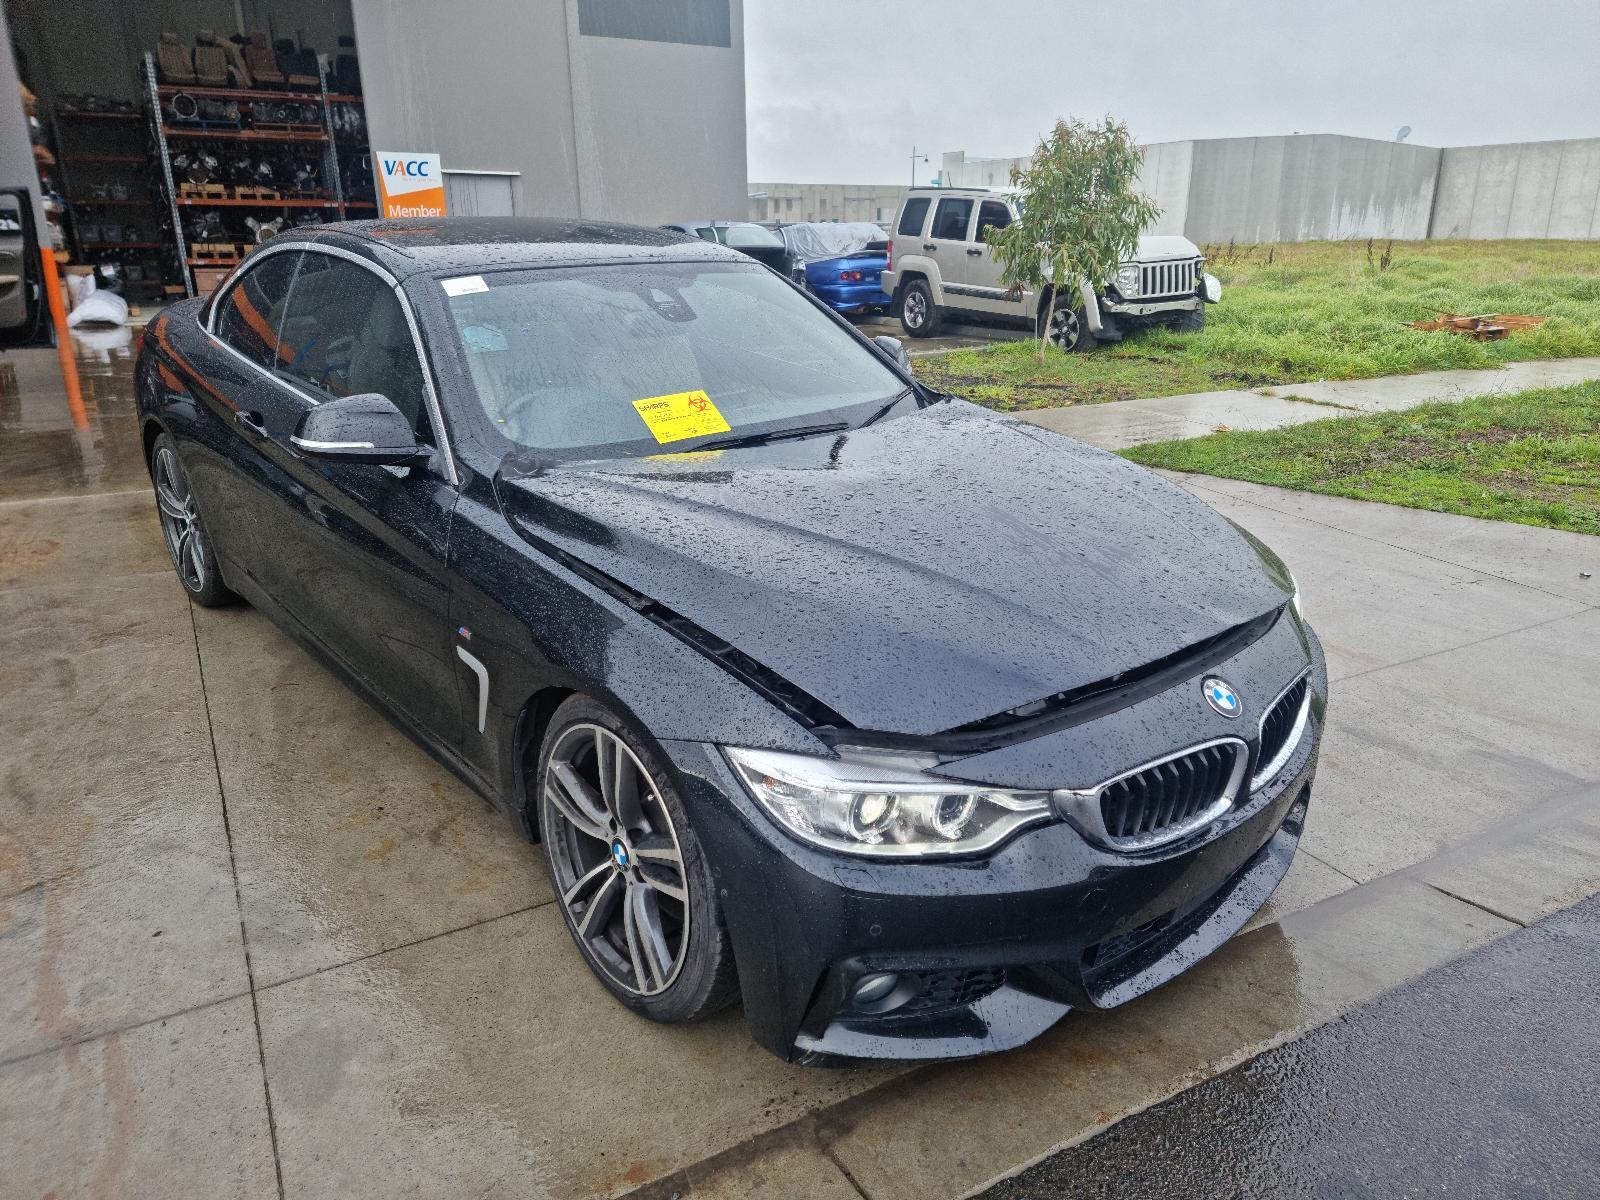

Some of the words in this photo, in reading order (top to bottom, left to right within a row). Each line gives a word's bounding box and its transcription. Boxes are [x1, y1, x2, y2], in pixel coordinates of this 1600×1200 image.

[384, 160, 429, 177] VACC
[388, 204, 442, 218] Member
[638, 401, 670, 412] SHARPS
